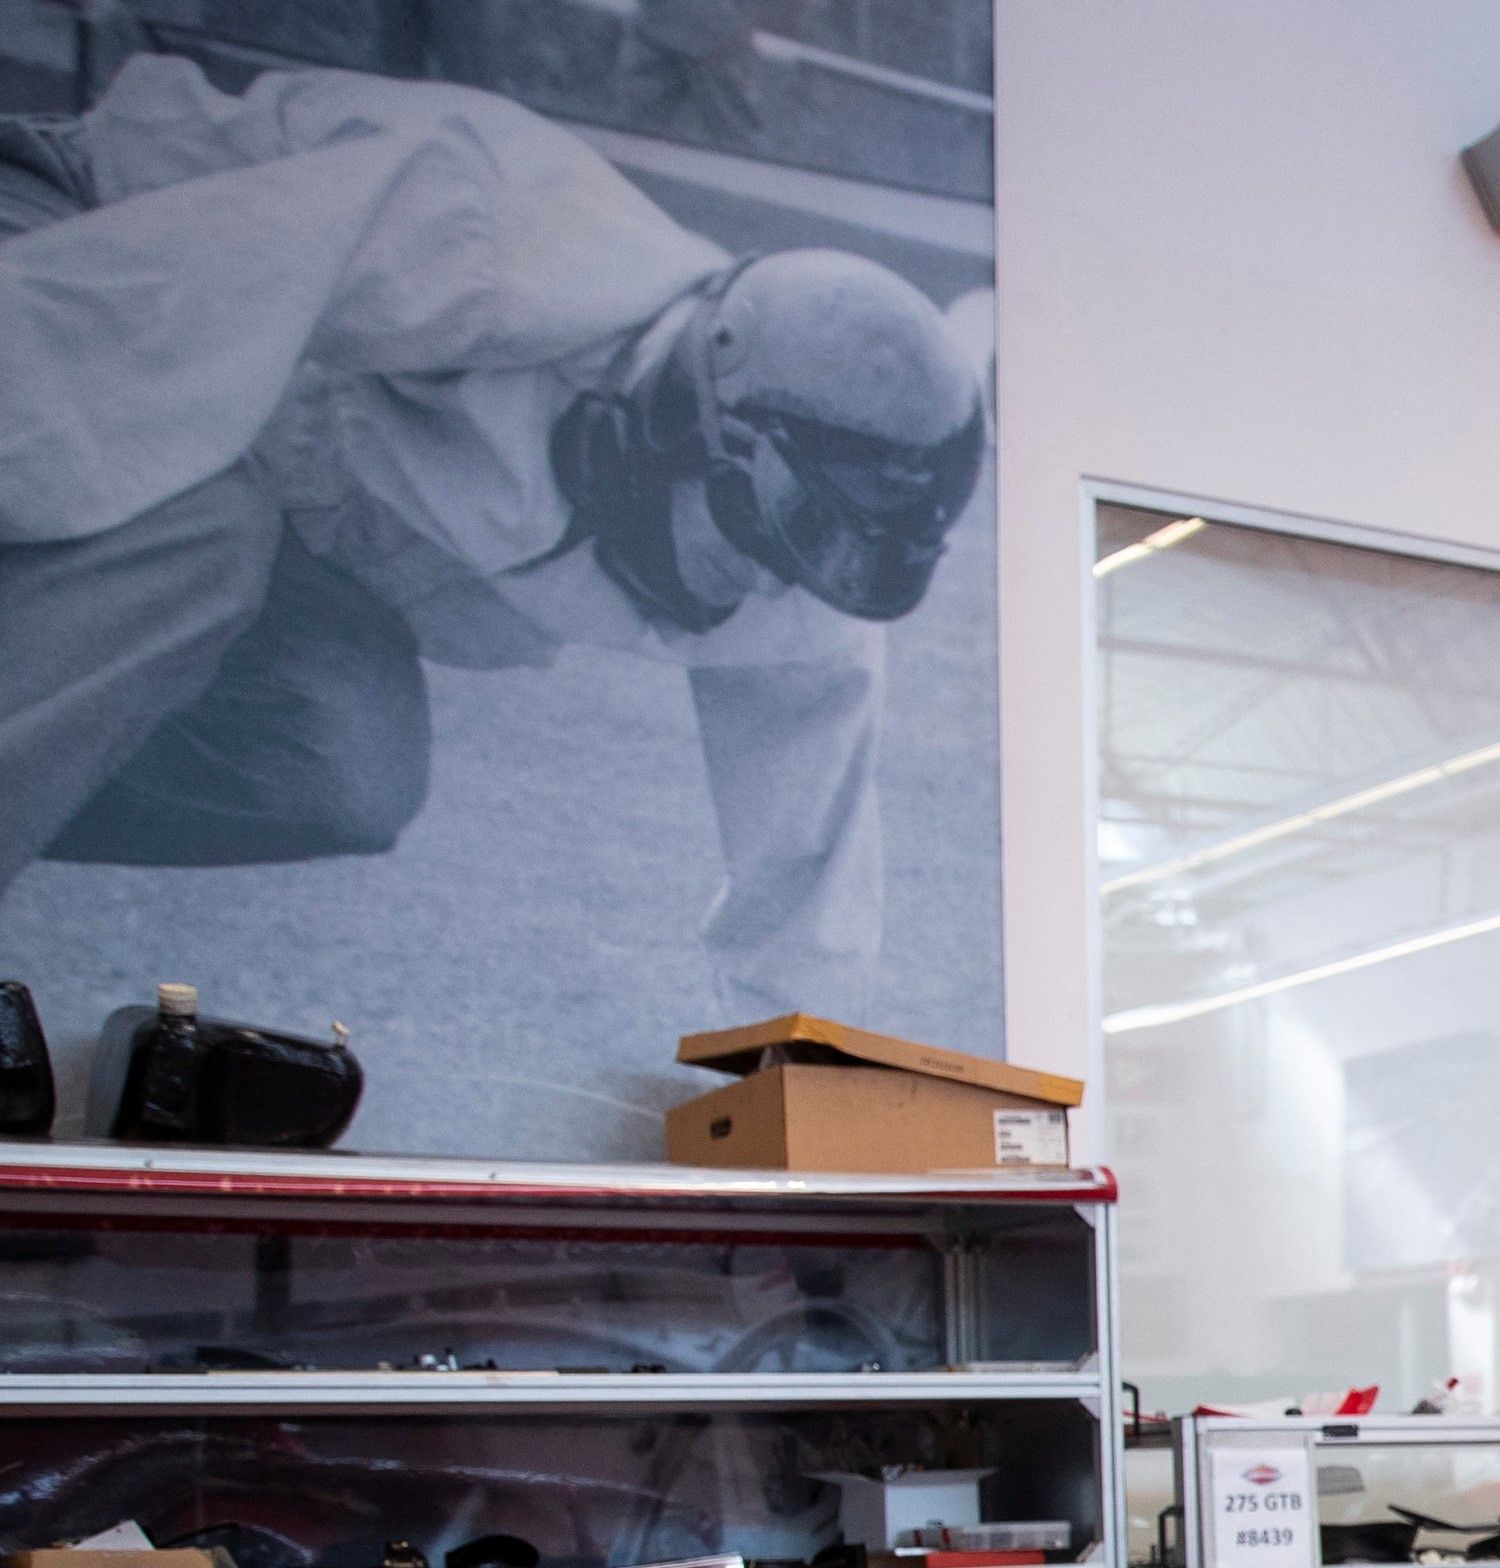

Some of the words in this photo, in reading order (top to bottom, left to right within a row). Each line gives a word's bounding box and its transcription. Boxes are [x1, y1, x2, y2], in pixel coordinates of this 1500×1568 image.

[1224, 1493, 1258, 1513] 275
[1264, 1493, 1303, 1512] GTB
[1236, 1529, 1294, 1548] #8439
